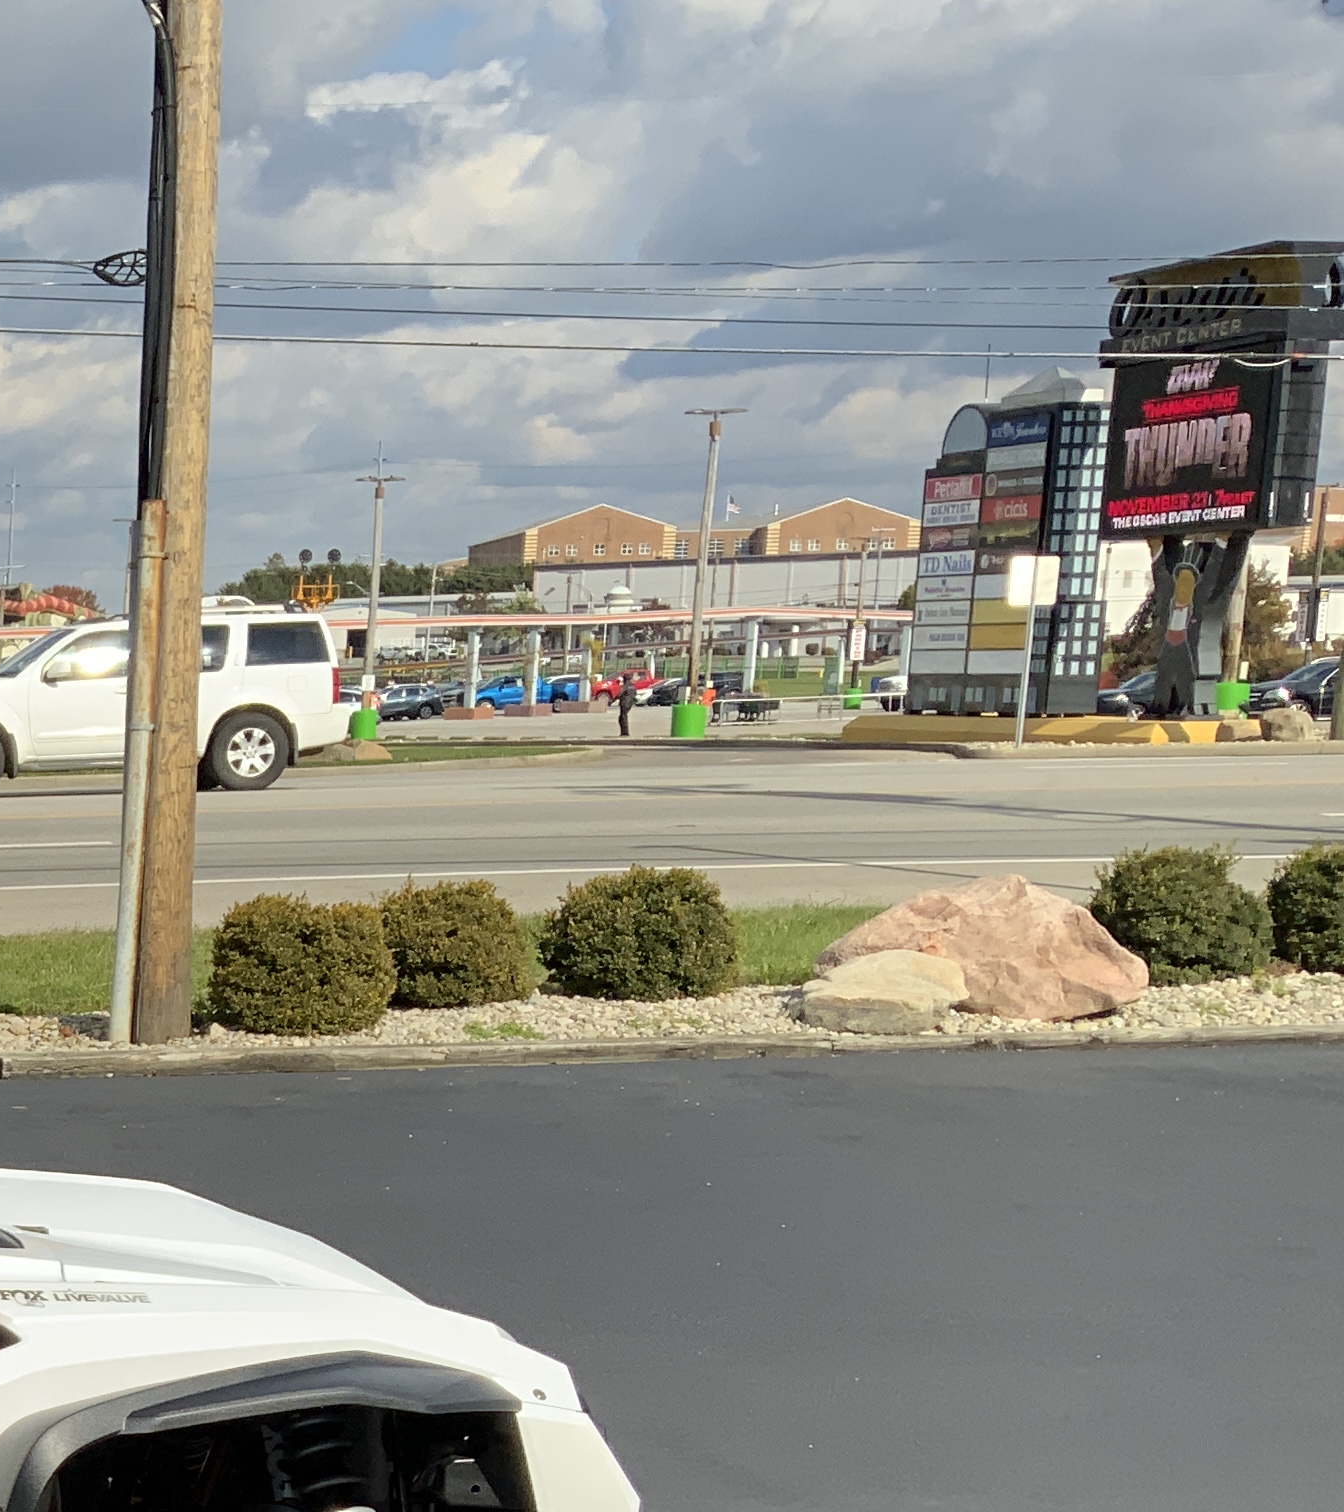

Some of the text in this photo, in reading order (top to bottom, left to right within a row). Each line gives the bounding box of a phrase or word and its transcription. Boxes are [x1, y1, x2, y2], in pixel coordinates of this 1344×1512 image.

[1120, 318, 1243, 353] EVENT CENTER
[1124, 413, 1252, 490] THUNDER
[931, 502, 972, 515] DENTIST
[1108, 492, 1189, 517] NOVEMBER
[1112, 505, 1245, 529] THE OSCAR EVENT CENTER
[923, 556, 940, 573] TD
[943, 553, 972, 573] Nails
